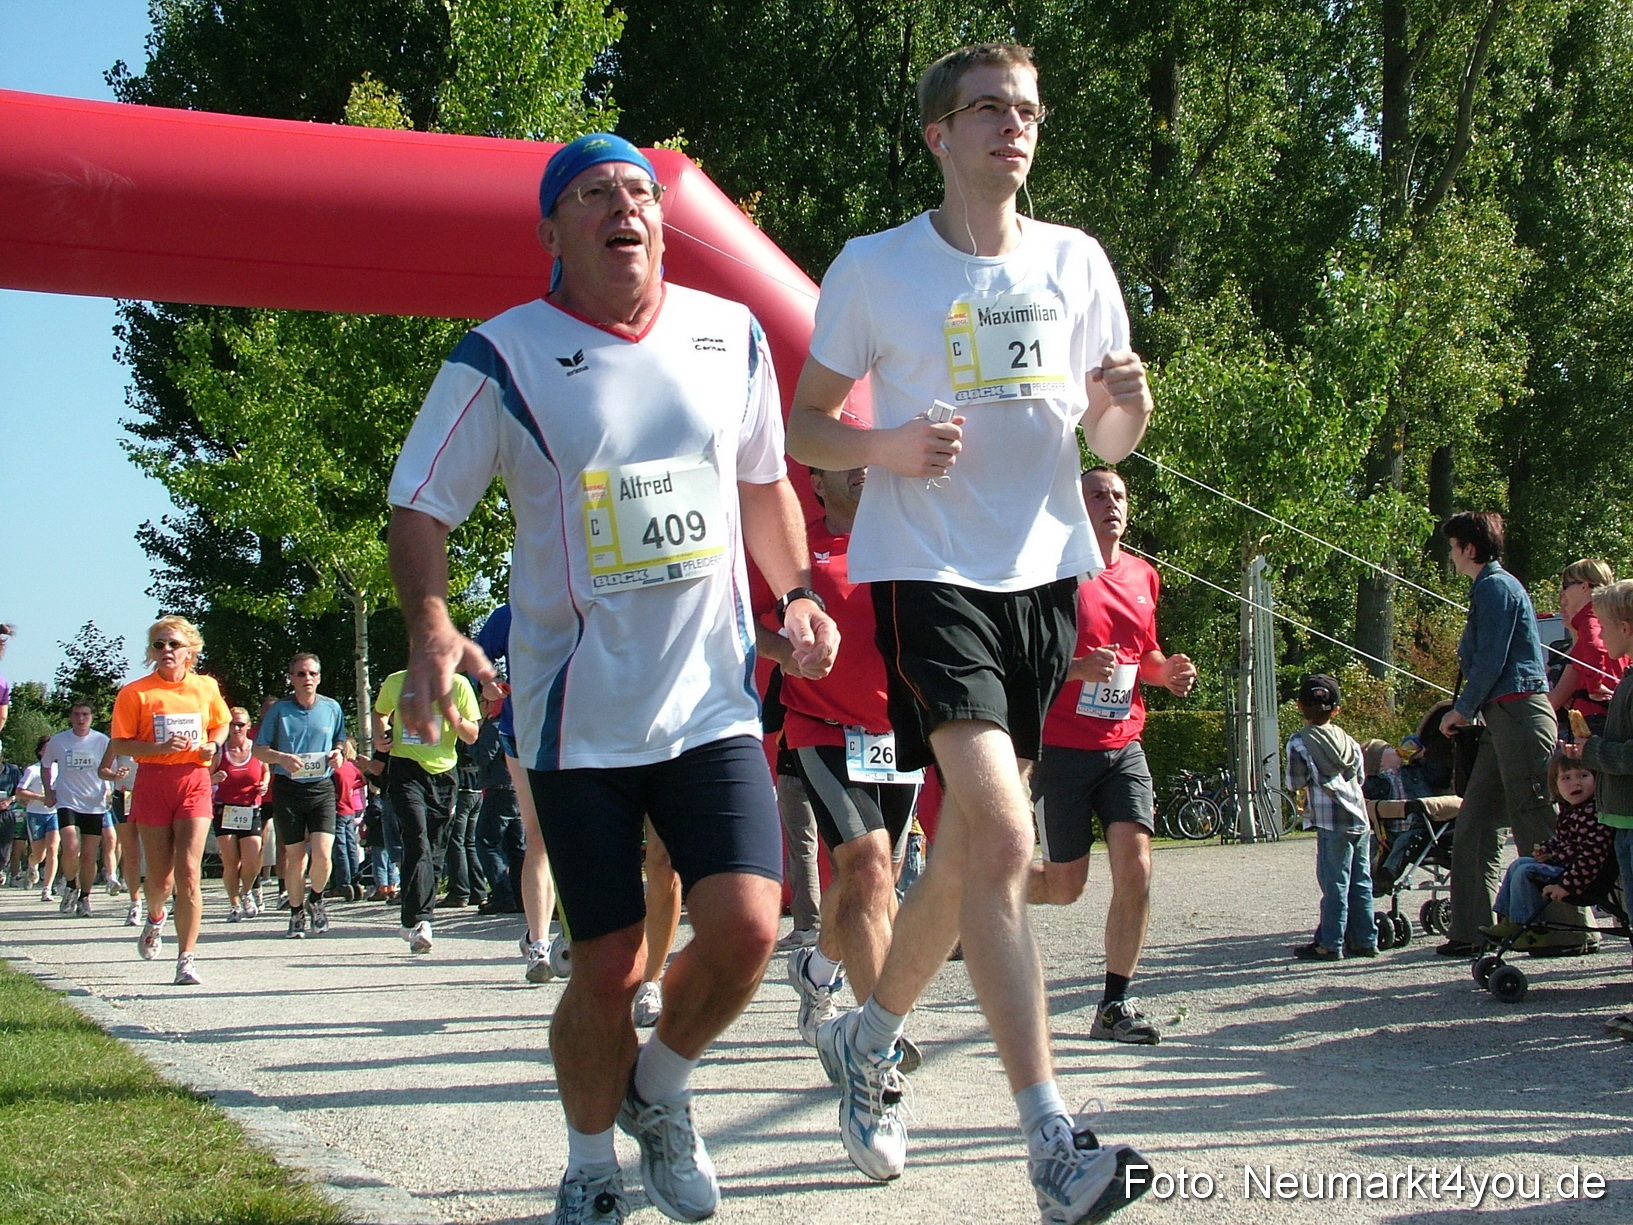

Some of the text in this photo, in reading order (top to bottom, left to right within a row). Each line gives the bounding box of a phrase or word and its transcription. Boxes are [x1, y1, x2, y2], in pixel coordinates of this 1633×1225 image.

[977, 303, 1058, 327] Maximilian
[952, 341, 962, 357] C
[1008, 339, 1043, 369] 21
[955, 385, 1004, 401] BOCK
[619, 471, 673, 501] Alfred
[590, 518, 600, 536] C
[642, 510, 707, 549] 409
[593, 568, 649, 588] BOCK
[1100, 687, 1131, 704] 3530
[849, 741, 855, 751] C
[869, 746, 893, 764] 26
[304, 761, 320, 770] 630
[233, 816, 248, 824] 419
